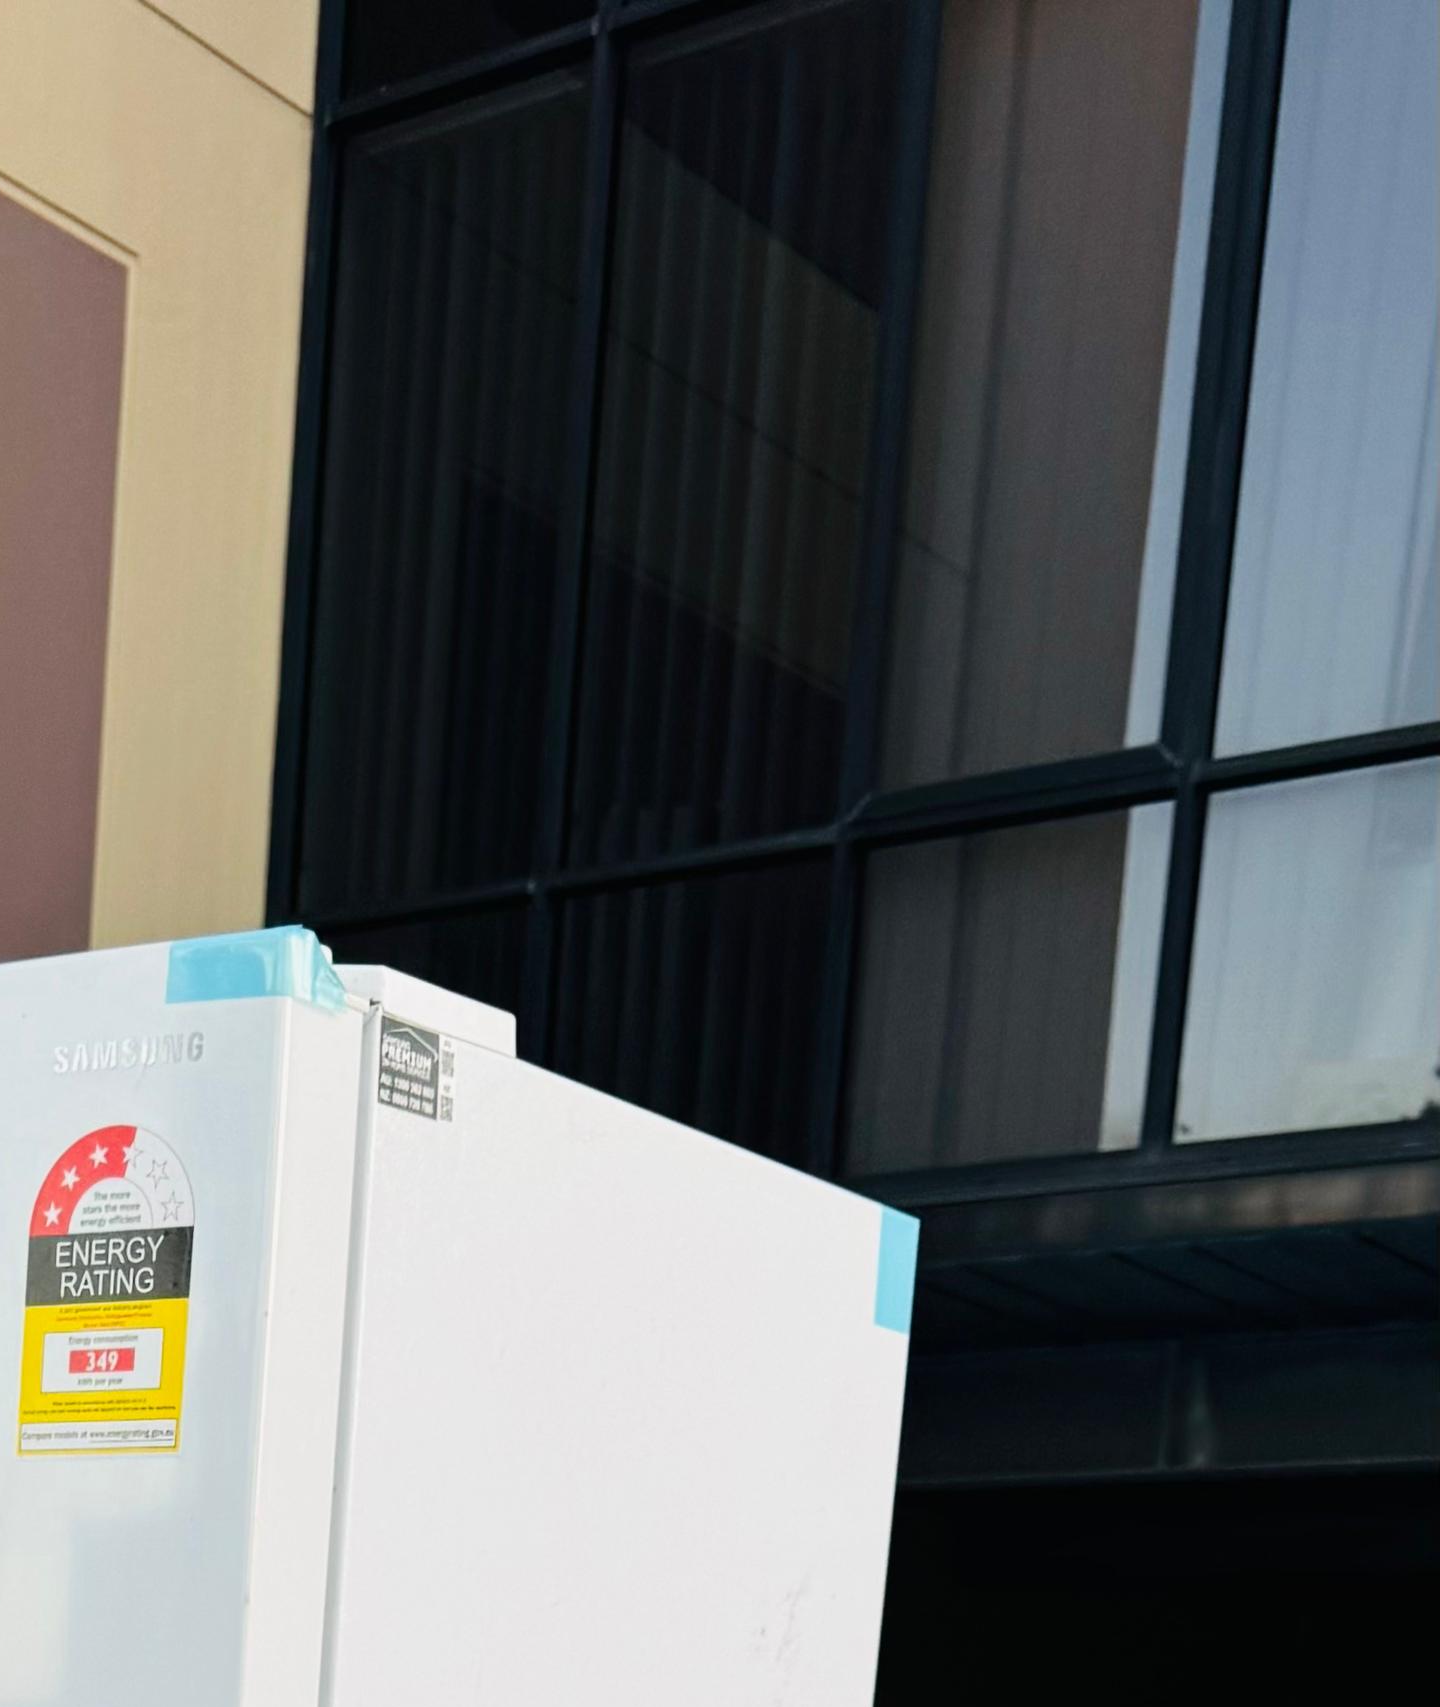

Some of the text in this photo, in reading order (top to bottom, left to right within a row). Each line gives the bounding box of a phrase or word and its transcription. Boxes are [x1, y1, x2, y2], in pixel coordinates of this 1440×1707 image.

[53, 1031, 205, 1074] SAMSUNG
[382, 1042, 432, 1072] PREMIUM
[55, 1234, 165, 1268] ENERGY
[60, 1267, 155, 1299] RATING
[85, 1350, 119, 1372] 349
